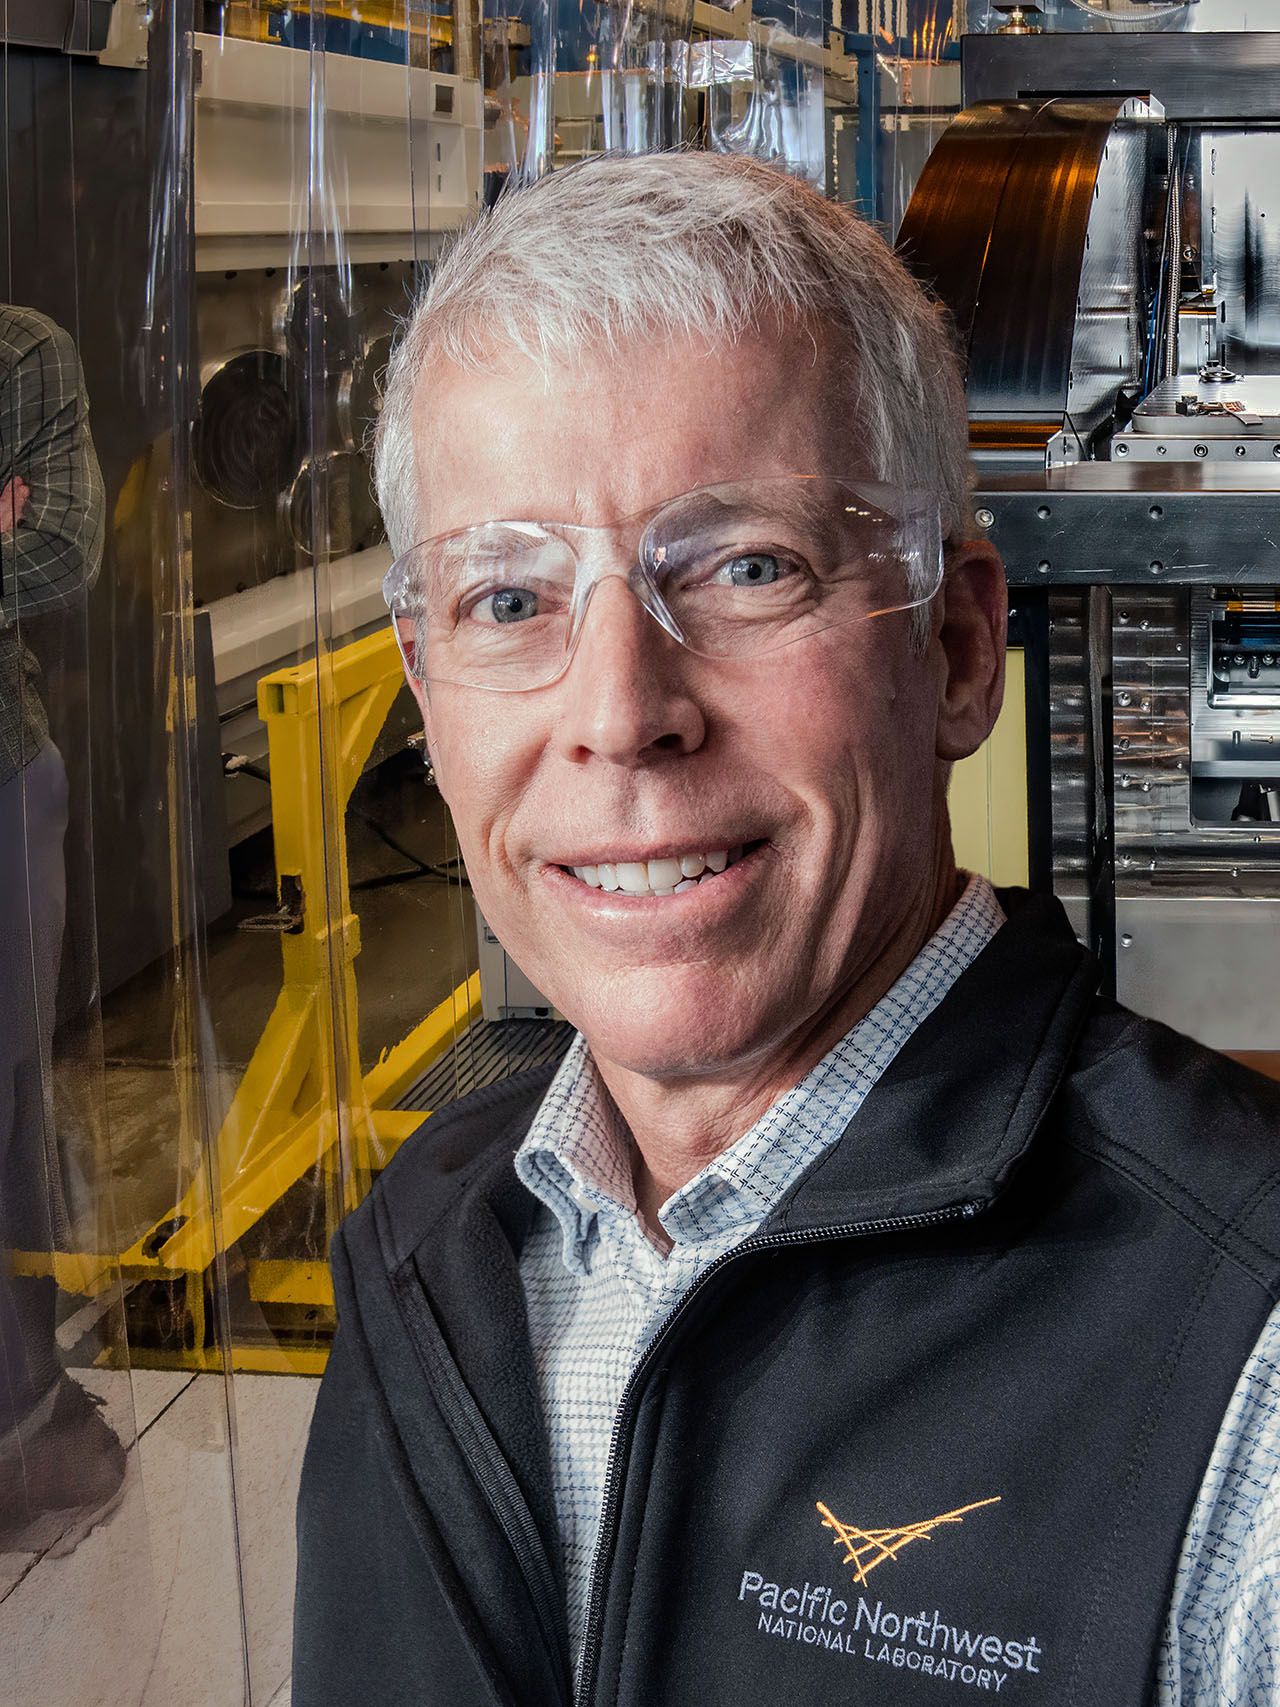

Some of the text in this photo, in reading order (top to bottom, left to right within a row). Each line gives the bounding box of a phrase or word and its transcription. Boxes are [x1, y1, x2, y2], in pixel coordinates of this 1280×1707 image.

[737, 1571, 1042, 1674] Pacific Northwest
[757, 1611, 1007, 1693] NATIONAL LABORATORY
